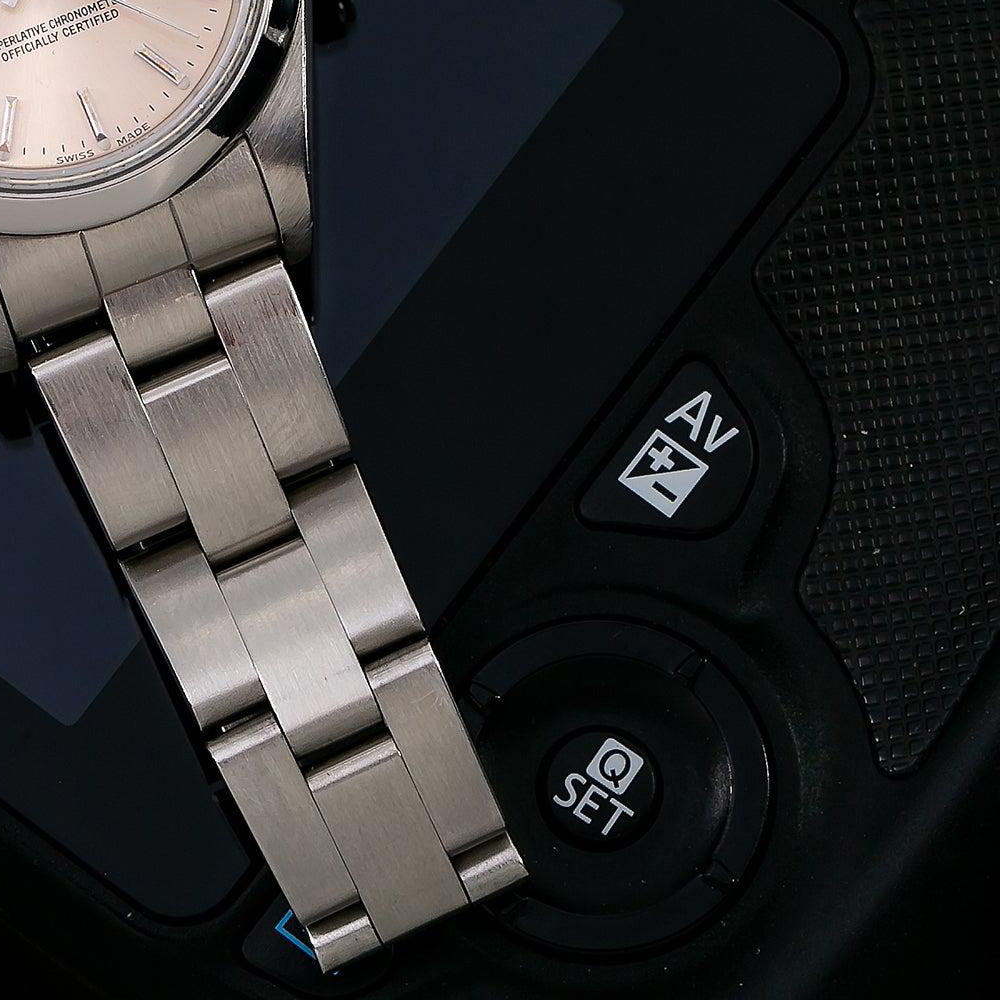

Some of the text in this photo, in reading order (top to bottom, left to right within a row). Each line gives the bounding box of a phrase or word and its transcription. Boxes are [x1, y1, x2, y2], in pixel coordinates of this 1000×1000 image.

[1, 8, 120, 62] OFFICIALLY CERTIFIED
[56, 122, 151, 165] SWISS MADE
[599, 748, 632, 788] Q
[552, 772, 635, 836] SET
